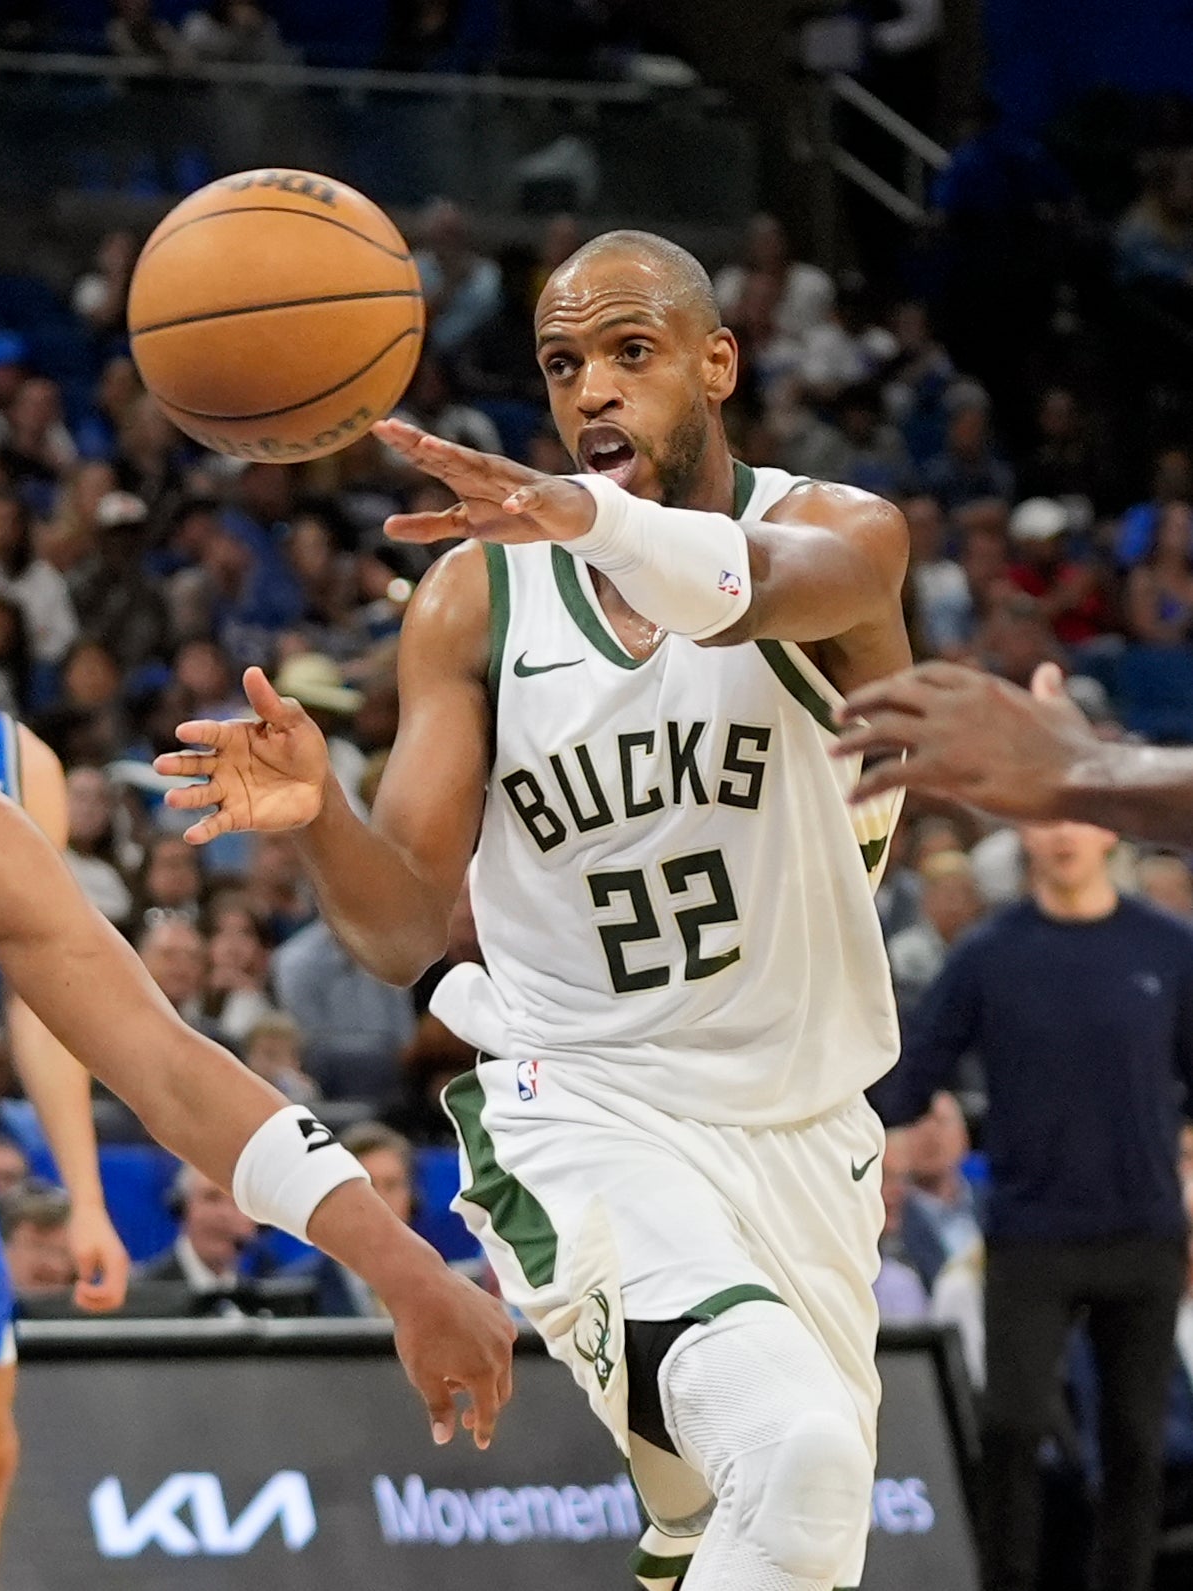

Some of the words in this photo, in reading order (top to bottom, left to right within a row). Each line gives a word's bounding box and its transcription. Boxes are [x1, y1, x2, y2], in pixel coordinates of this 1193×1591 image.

[501, 720, 772, 854] BUCKS
[586, 848, 741, 994] 22
[89, 1469, 317, 1558] KIA
[372, 1473, 641, 1545] Movement
